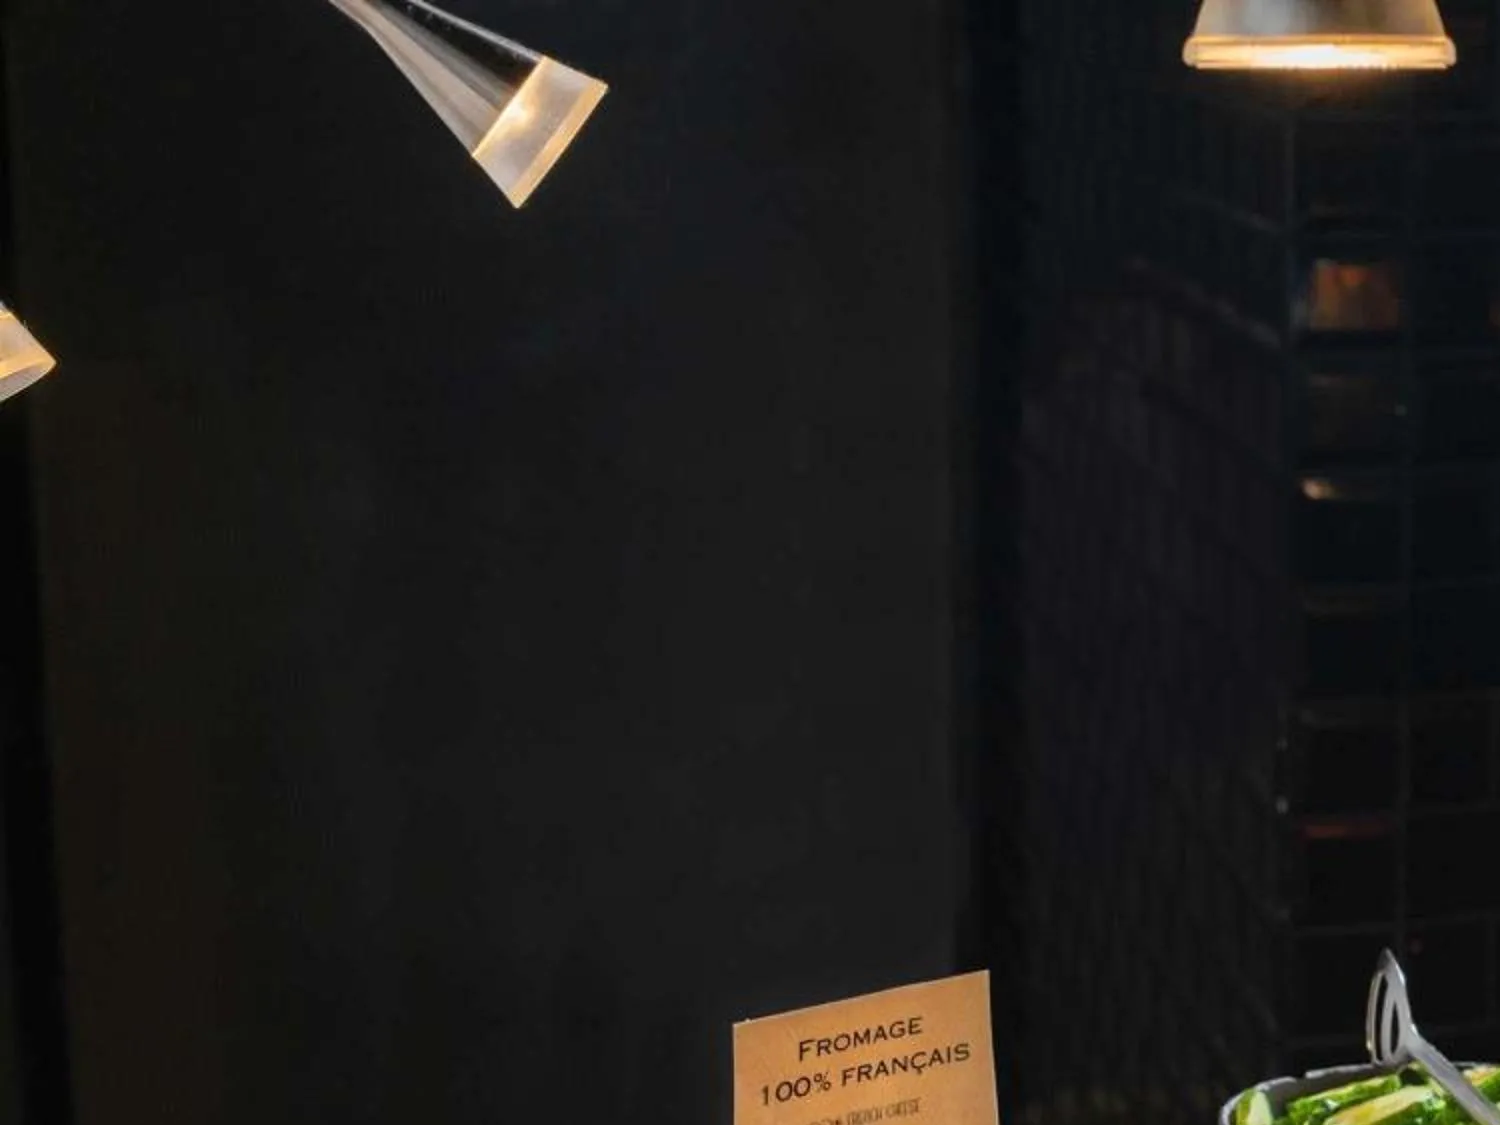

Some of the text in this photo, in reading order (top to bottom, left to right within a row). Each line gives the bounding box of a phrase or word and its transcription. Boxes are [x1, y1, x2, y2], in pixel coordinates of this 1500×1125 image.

[798, 1016, 924, 1062] FROMAGE
[761, 1043, 972, 1105] 100% FRANÇAIS
